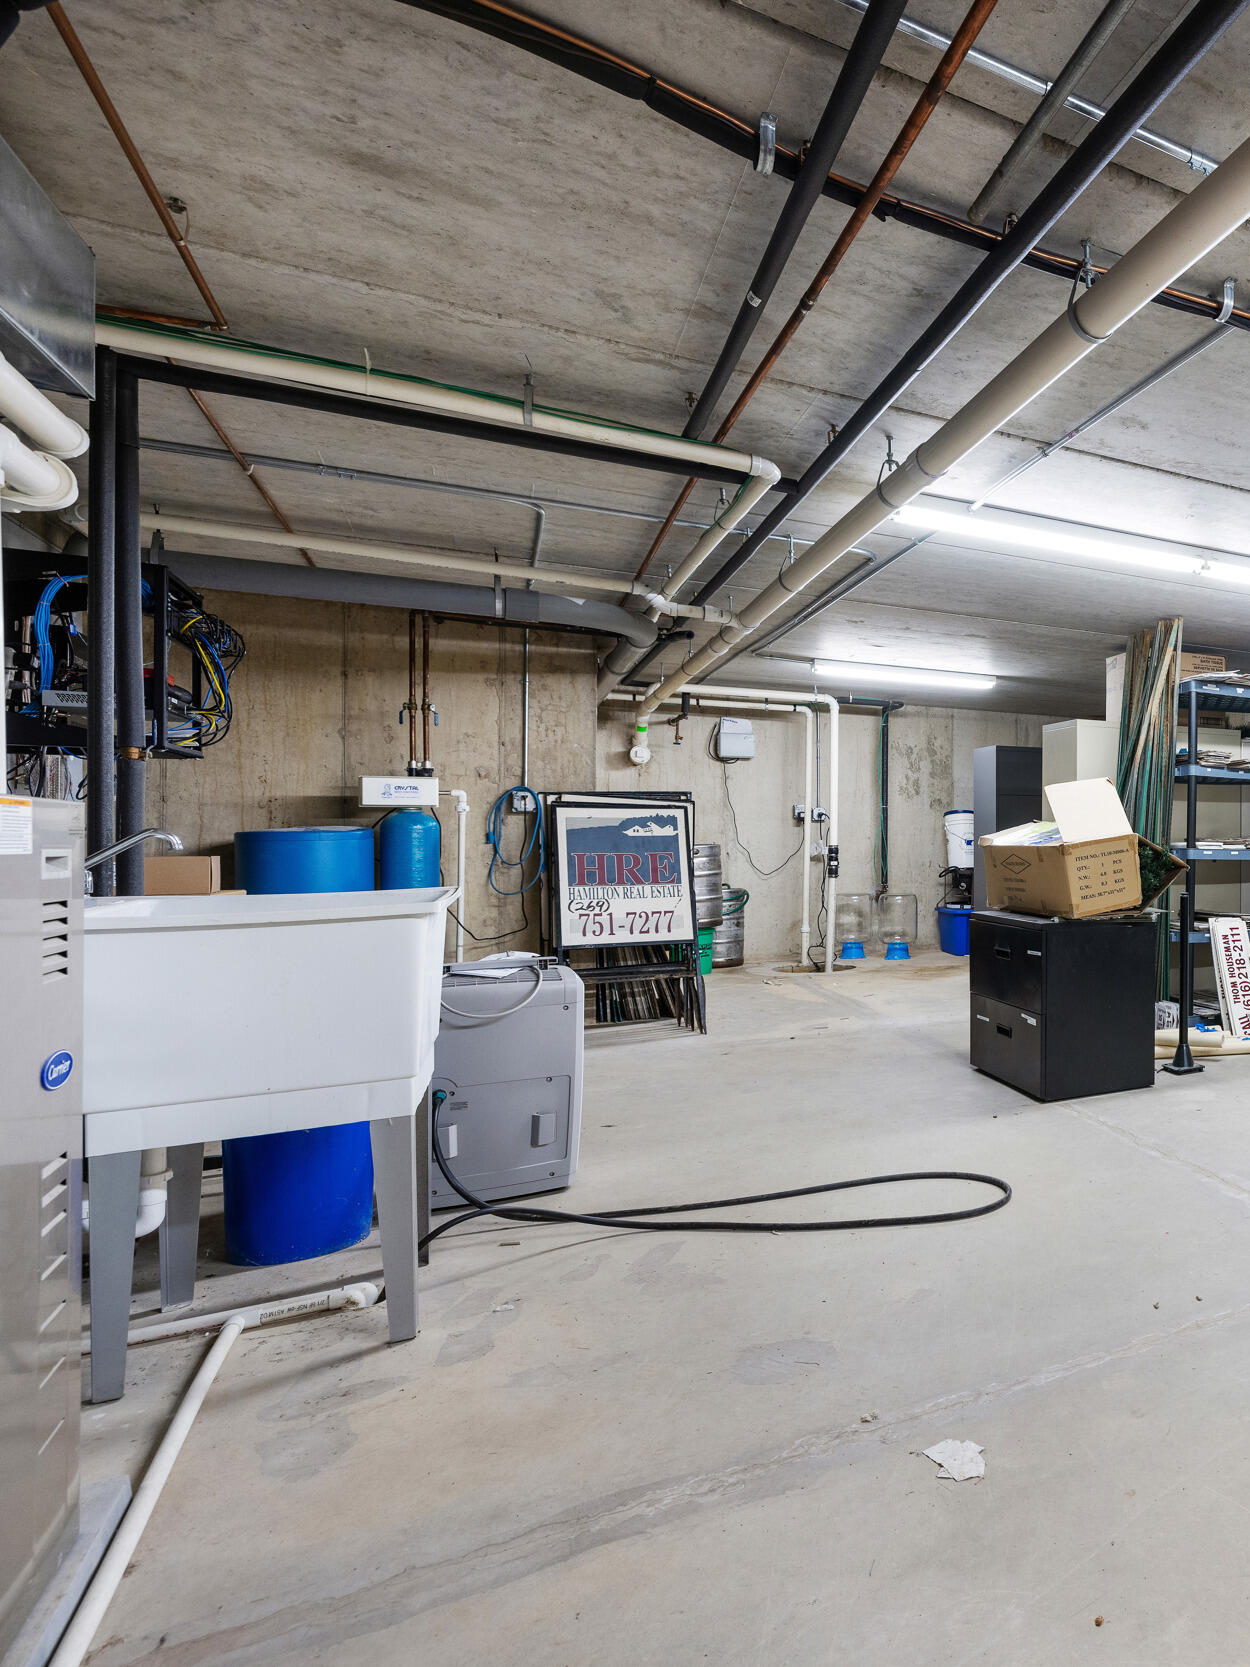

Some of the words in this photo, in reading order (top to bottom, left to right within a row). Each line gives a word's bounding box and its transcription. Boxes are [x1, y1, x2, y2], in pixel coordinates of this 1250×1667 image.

[571, 852, 677, 886] HRE
[568, 886, 621, 901] HAMILTON
[623, 886, 648, 899] REAL
[650, 884, 683, 898] ESTATE
[567, 899, 610, 913] (269)
[578, 910, 675, 937] 751-7277
[1222, 934, 1237, 979] HOUSEMAN
[1229, 981, 1242, 1004] THOM
[48, 1060, 71, 1080] Carrier
